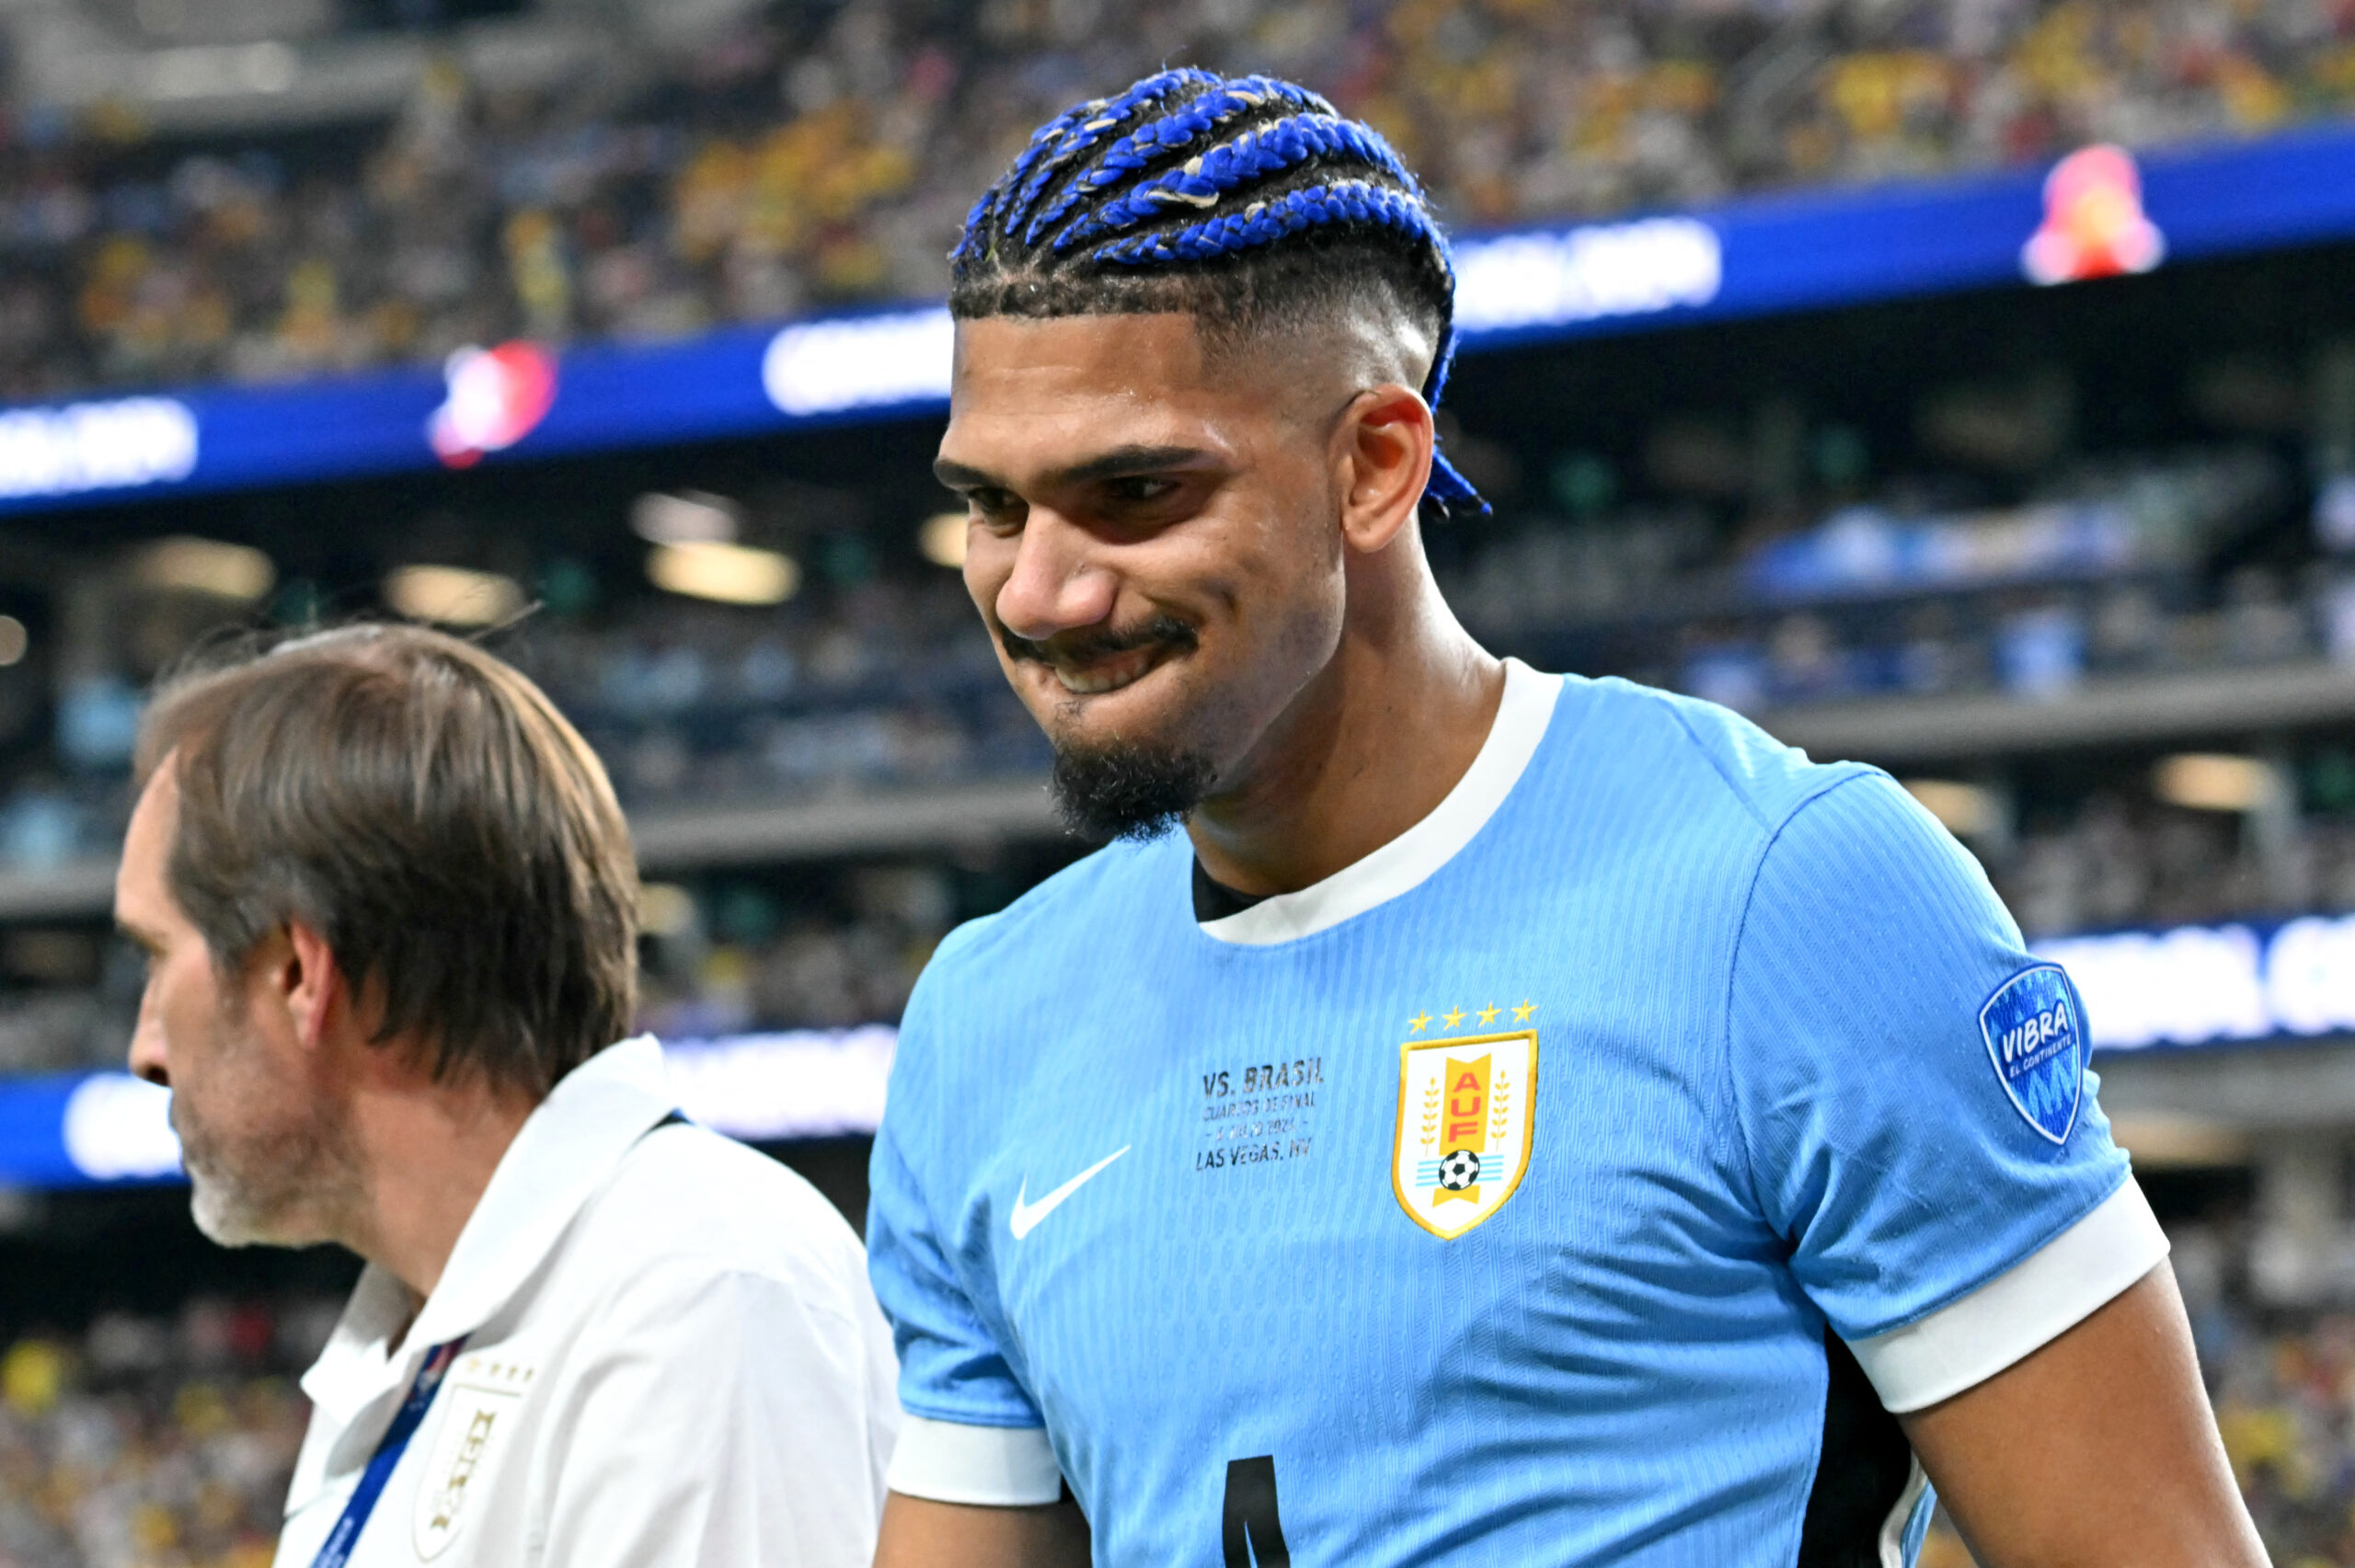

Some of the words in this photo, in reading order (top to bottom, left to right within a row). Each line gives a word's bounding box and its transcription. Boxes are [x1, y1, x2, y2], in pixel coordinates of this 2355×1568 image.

[2003, 1001, 2069, 1063] VIBRA
[2009, 1065, 2022, 1079] EL
[2023, 1032, 2073, 1072] CONTINENTE
[1202, 1070, 1236, 1100] VS.
[1243, 1057, 1325, 1093] BRASIL
[1281, 1091, 1316, 1109] FINAL
[1448, 1072, 1482, 1143] AUF
[1196, 1148, 1225, 1172] LAS
[1289, 1137, 1313, 1159] NV
